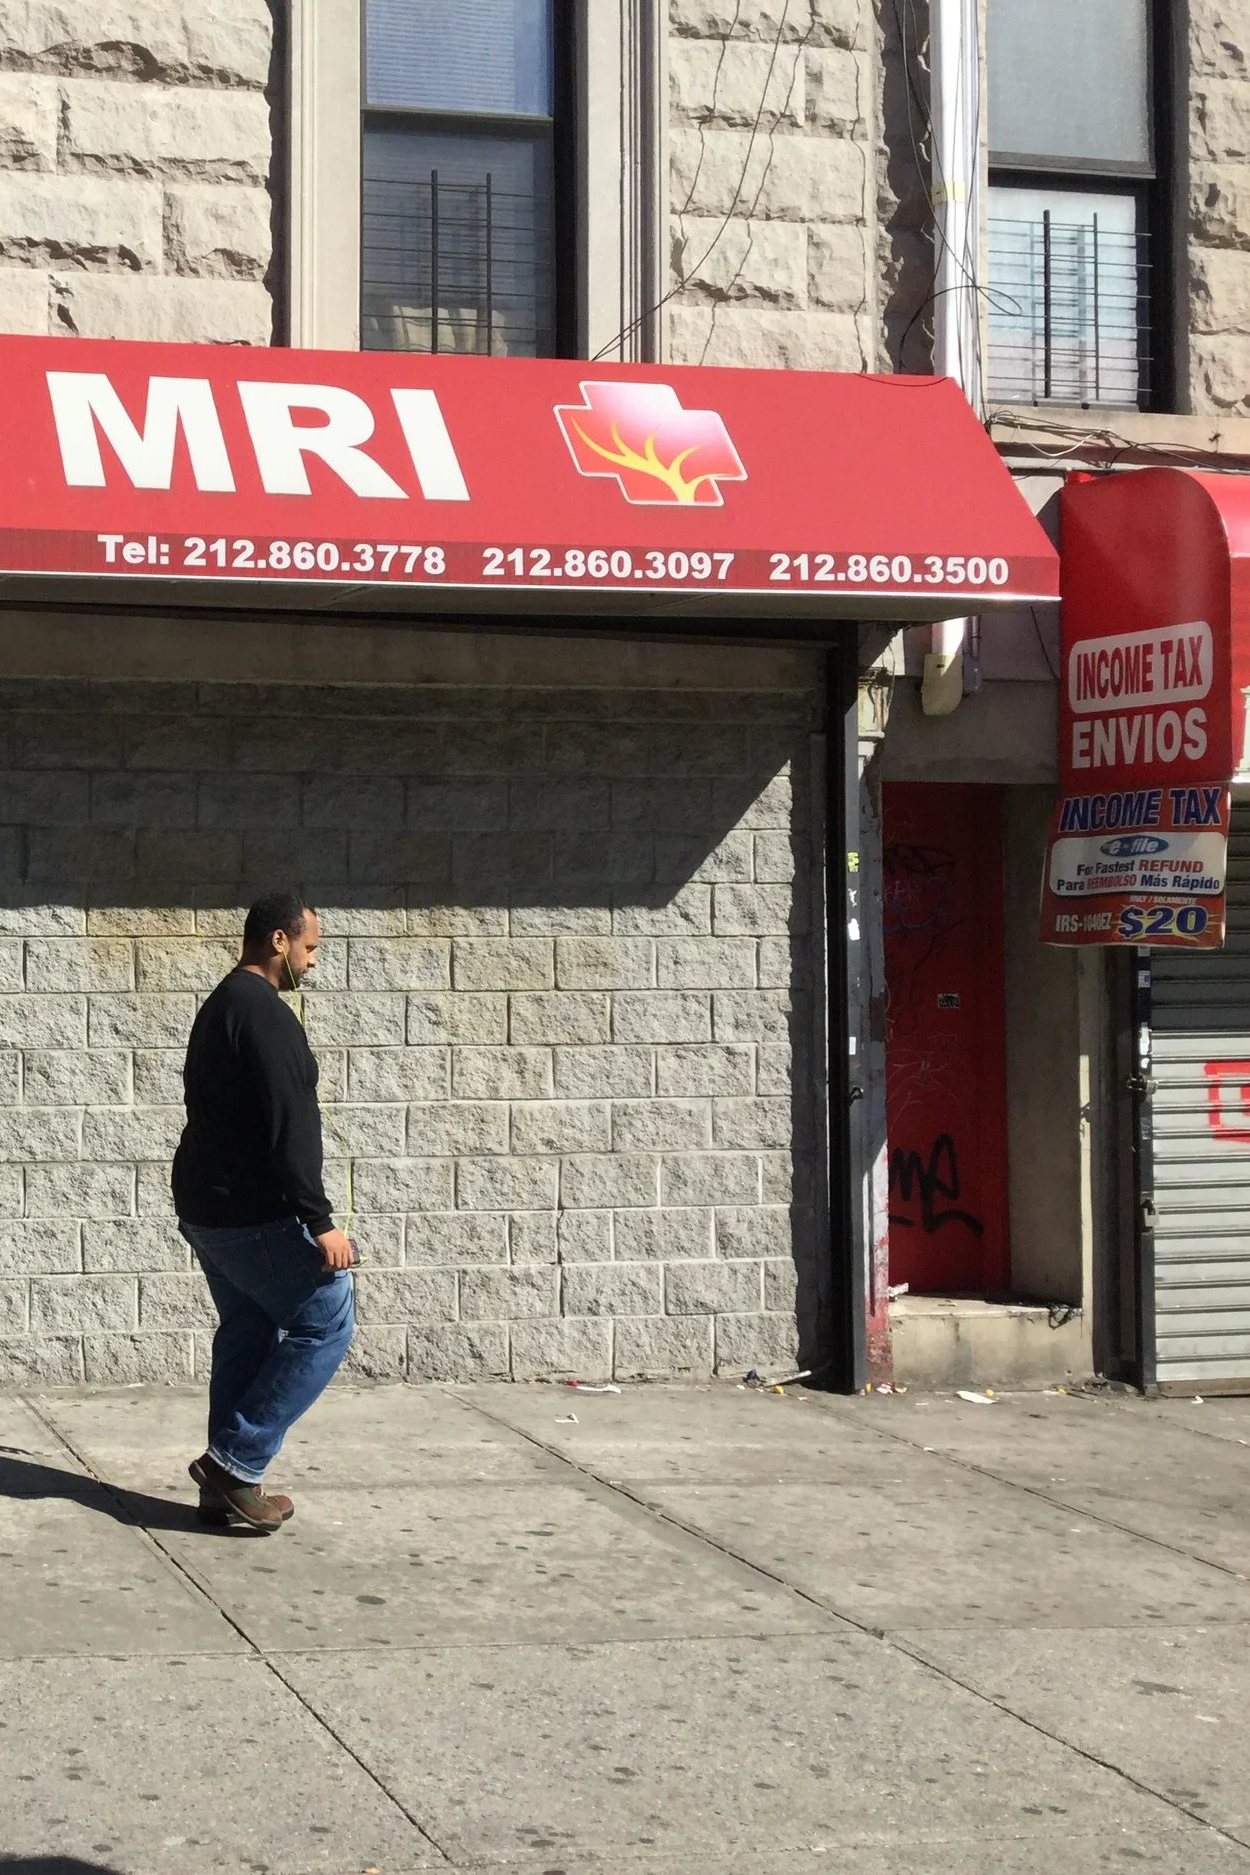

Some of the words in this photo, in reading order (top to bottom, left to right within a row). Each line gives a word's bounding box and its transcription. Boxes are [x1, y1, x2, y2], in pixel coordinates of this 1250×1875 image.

[46, 371, 470, 501] MRI
[98, 535, 169, 565] Tel:
[184, 537, 445, 574] 212.860.3778
[483, 548, 734, 580] 212.860.3097
[770, 554, 1008, 585] 212.860.3500
[1076, 643, 1154, 700] INCOME
[1160, 635, 1203, 689] TAX
[1072, 707, 1207, 769] ENVIOS
[1059, 790, 1162, 832] INCOME
[1168, 786, 1221, 826] TAX
[1057, 879, 1085, 891] Para
[1140, 874, 1168, 888] Más
[1172, 875, 1220, 890] Rápido
[1096, 860, 1135, 874] Fastest
[1138, 859, 1204, 873] REFUND
[1117, 905, 1209, 938] $20
